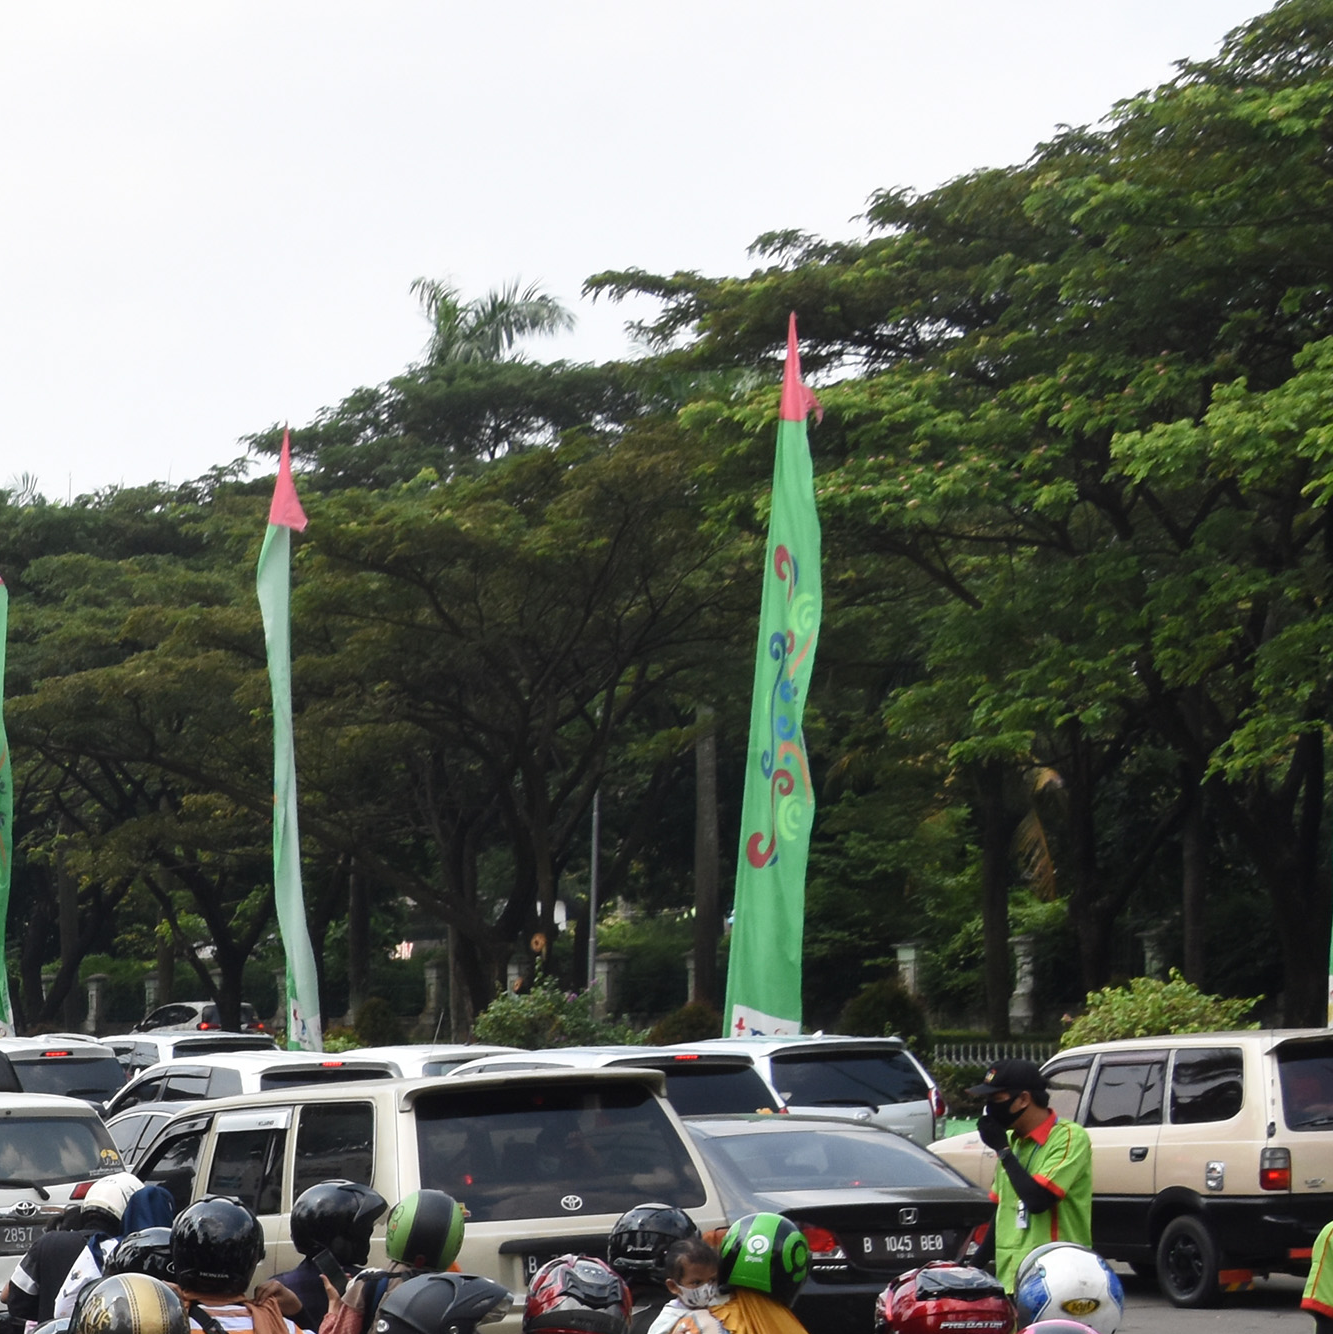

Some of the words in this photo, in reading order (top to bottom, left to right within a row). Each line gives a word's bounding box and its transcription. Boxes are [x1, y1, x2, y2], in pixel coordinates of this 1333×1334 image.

[4, 1227, 33, 1243] 2857
[863, 1238, 872, 1252] B
[884, 1235, 912, 1252] 1045
[199, 1271, 230, 1279] HONDA
[939, 1320, 1005, 1330] PREDATOR
